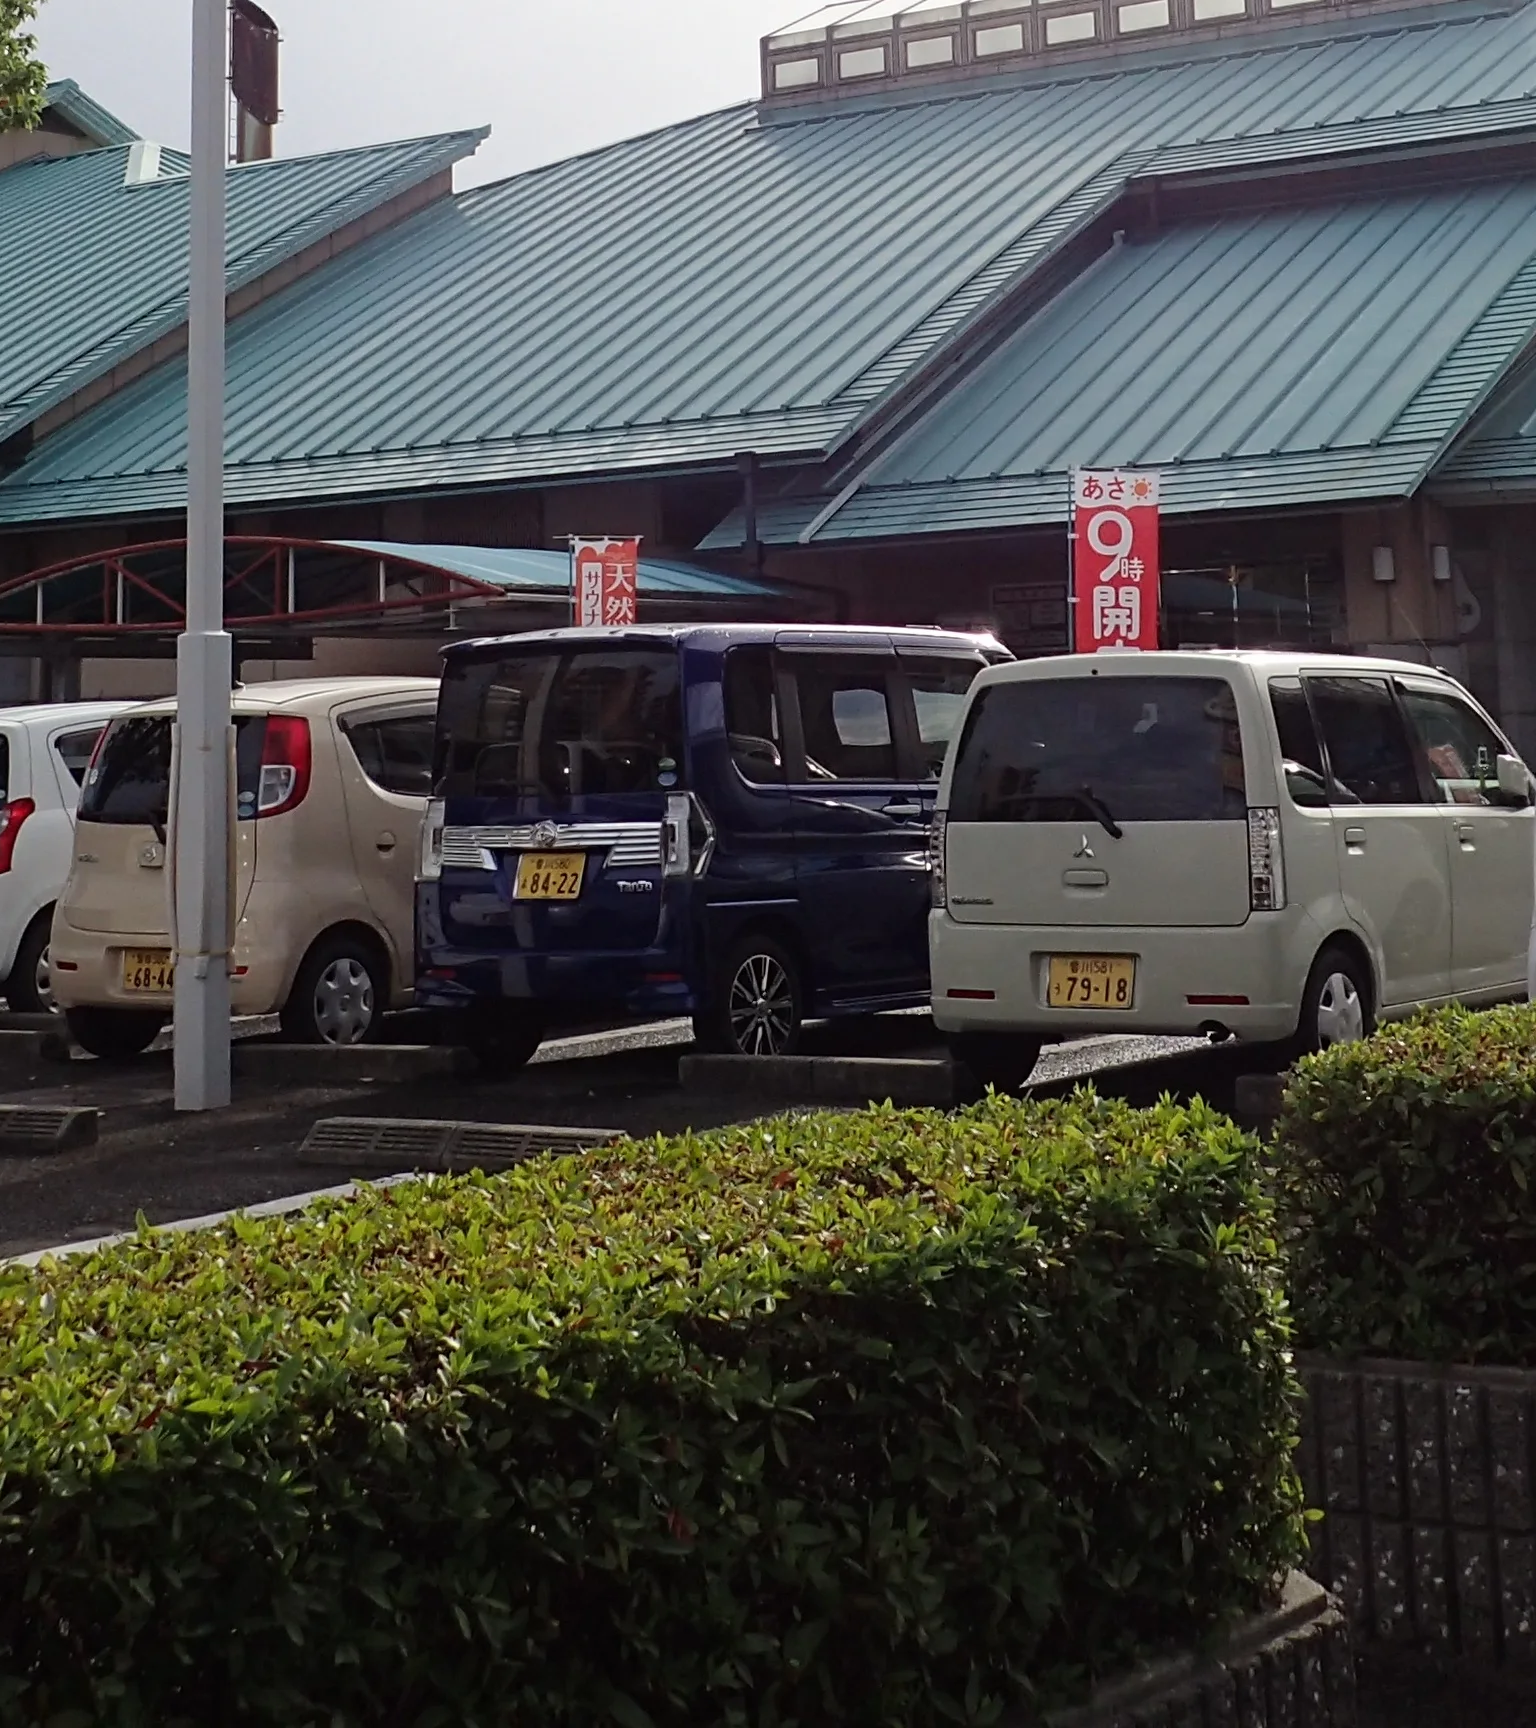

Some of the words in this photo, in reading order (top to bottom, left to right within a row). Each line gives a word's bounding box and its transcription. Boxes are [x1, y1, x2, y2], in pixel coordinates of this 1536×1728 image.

[1082, 476, 1126, 500] あさ
[584, 571, 601, 627] サウナ
[605, 562, 634, 626] 天然
[1066, 977, 1128, 1003] 79-18
